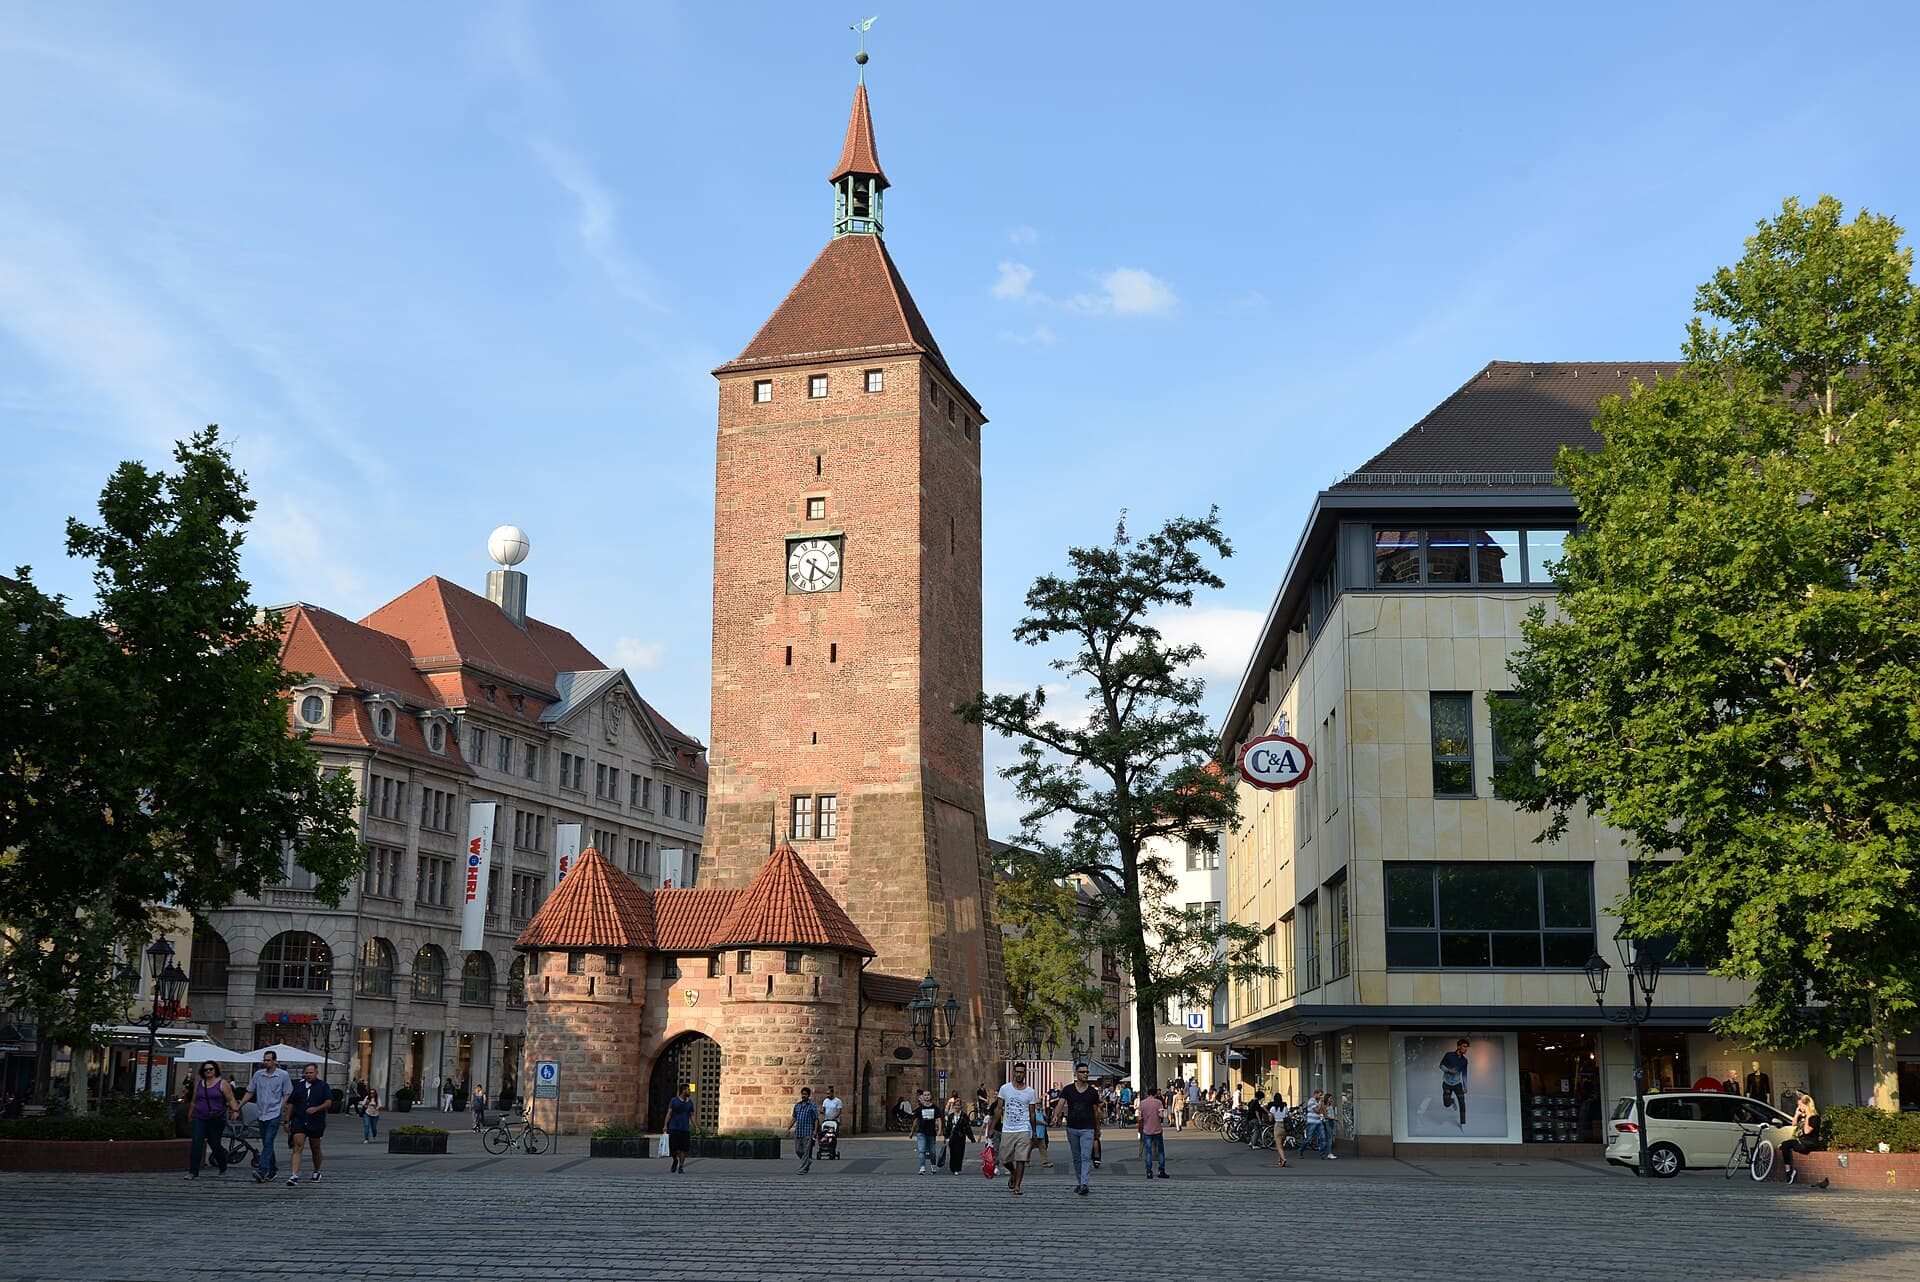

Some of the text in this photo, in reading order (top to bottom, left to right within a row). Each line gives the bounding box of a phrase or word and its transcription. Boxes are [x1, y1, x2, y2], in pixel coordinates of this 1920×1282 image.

[1251, 749, 1300, 774] C&A
[465, 836, 482, 905] WÖHRL
[1189, 1014, 1202, 1028] U
